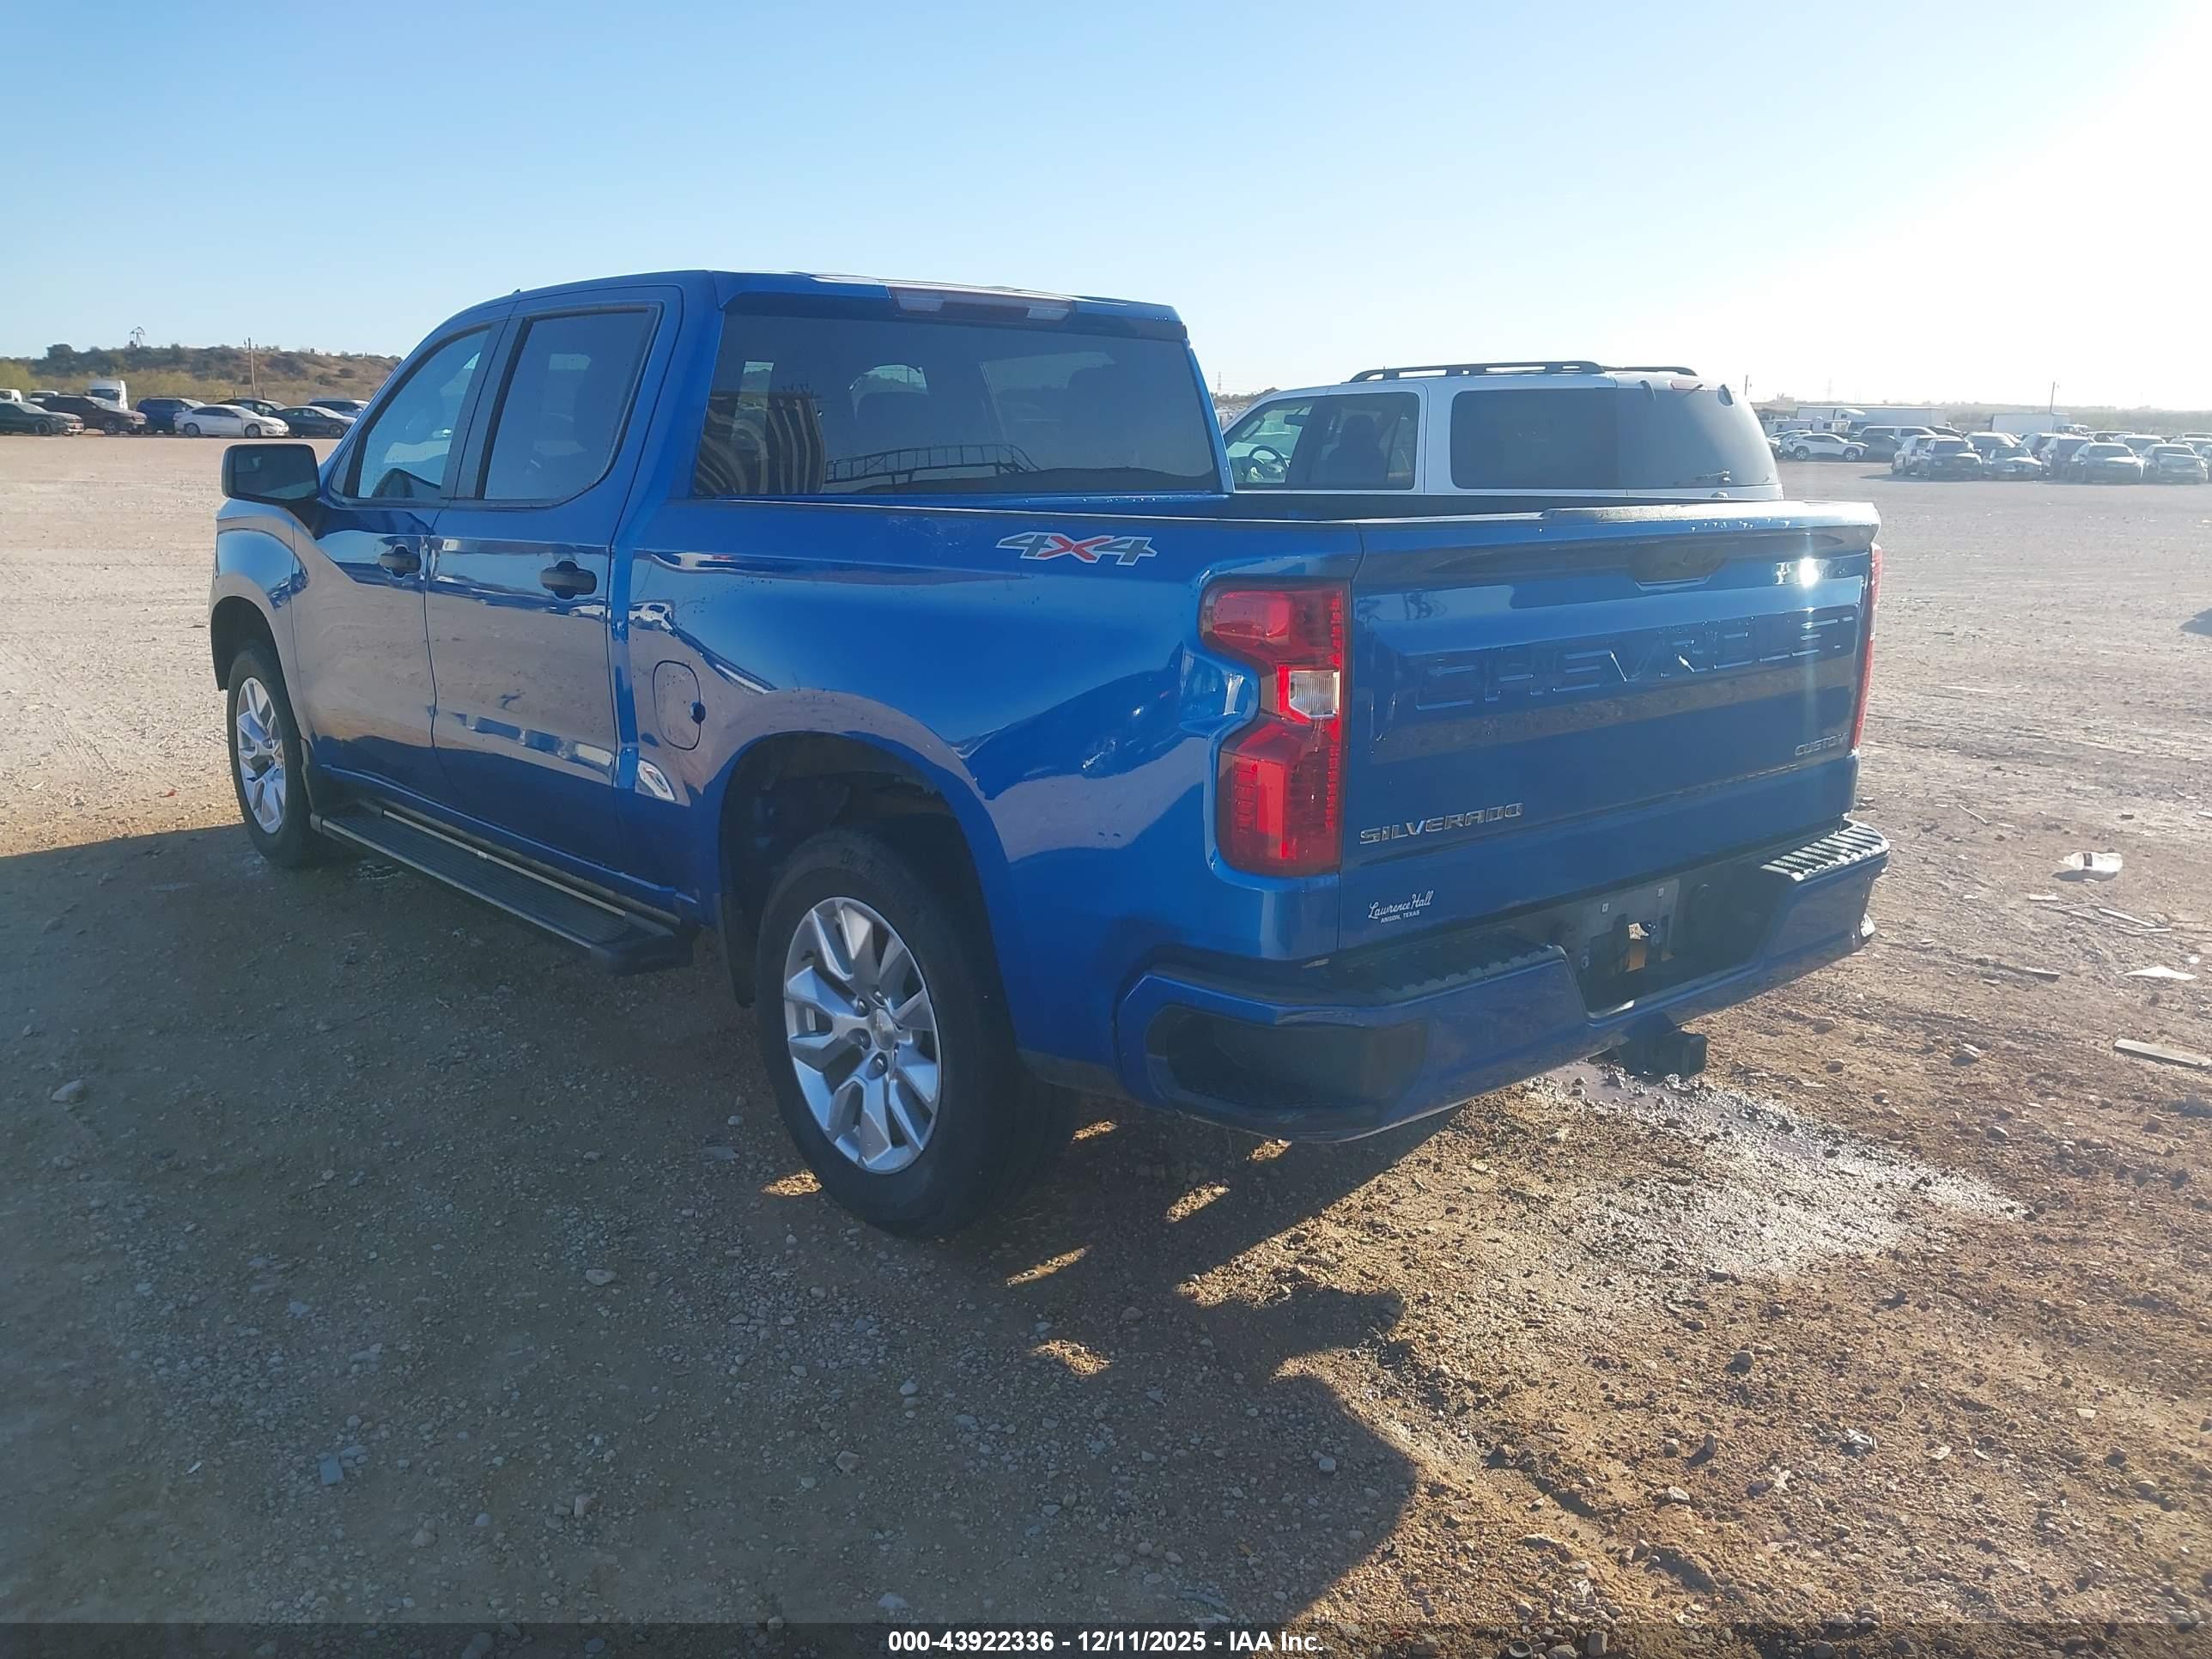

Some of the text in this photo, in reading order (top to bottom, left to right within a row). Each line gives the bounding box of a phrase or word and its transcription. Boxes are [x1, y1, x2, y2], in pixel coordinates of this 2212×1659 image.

[1416, 611, 1855, 711] CHEVROLET
[1359, 802, 1524, 845] SILVERADO
[1368, 890, 1434, 920] Lawrence Hall
[1403, 909, 1420, 919] TEXAS
